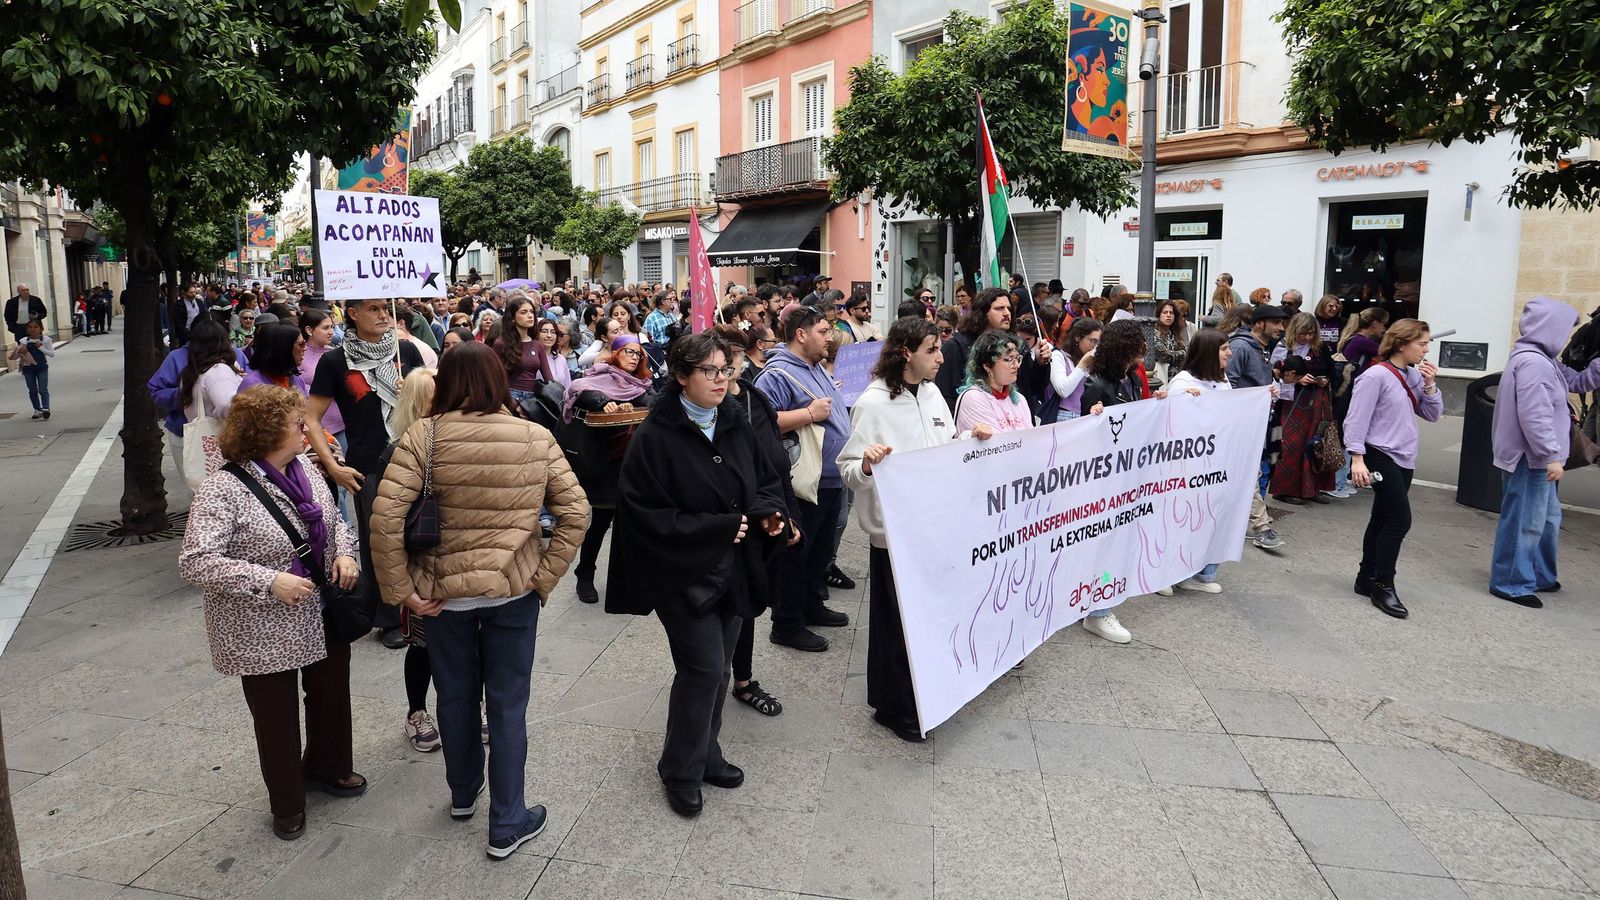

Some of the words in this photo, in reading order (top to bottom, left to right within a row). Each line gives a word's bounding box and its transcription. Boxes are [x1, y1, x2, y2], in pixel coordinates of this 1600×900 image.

[1109, 17, 1128, 42] 30
[1317, 161, 1405, 182] CATCHALOT
[336, 195, 420, 218] ALIADOS
[324, 222, 434, 243] ACOMPAÑAN
[1355, 218, 1401, 226] REBAJAS
[645, 226, 671, 240] MISAKO
[373, 247, 388, 257] EN
[391, 248, 404, 258] LA
[357, 259, 418, 279] LUCHA
[987, 484, 1007, 516] NI
[1012, 455, 1112, 505] TRADWIVES
[1116, 447, 1134, 473] NI
[1137, 433, 1216, 469] GYMBROS
[971, 541, 997, 566] POR
[999, 532, 1015, 554] UN
[1016, 497, 1106, 545] TRANSFEMINISMO
[1107, 477, 1187, 511] ANTICAPITALISTA
[1189, 470, 1228, 489] CONTRA
[1050, 534, 1064, 553] LA
[1066, 518, 1113, 547] EXTREMA
[1113, 501, 1154, 529] DERECHA
